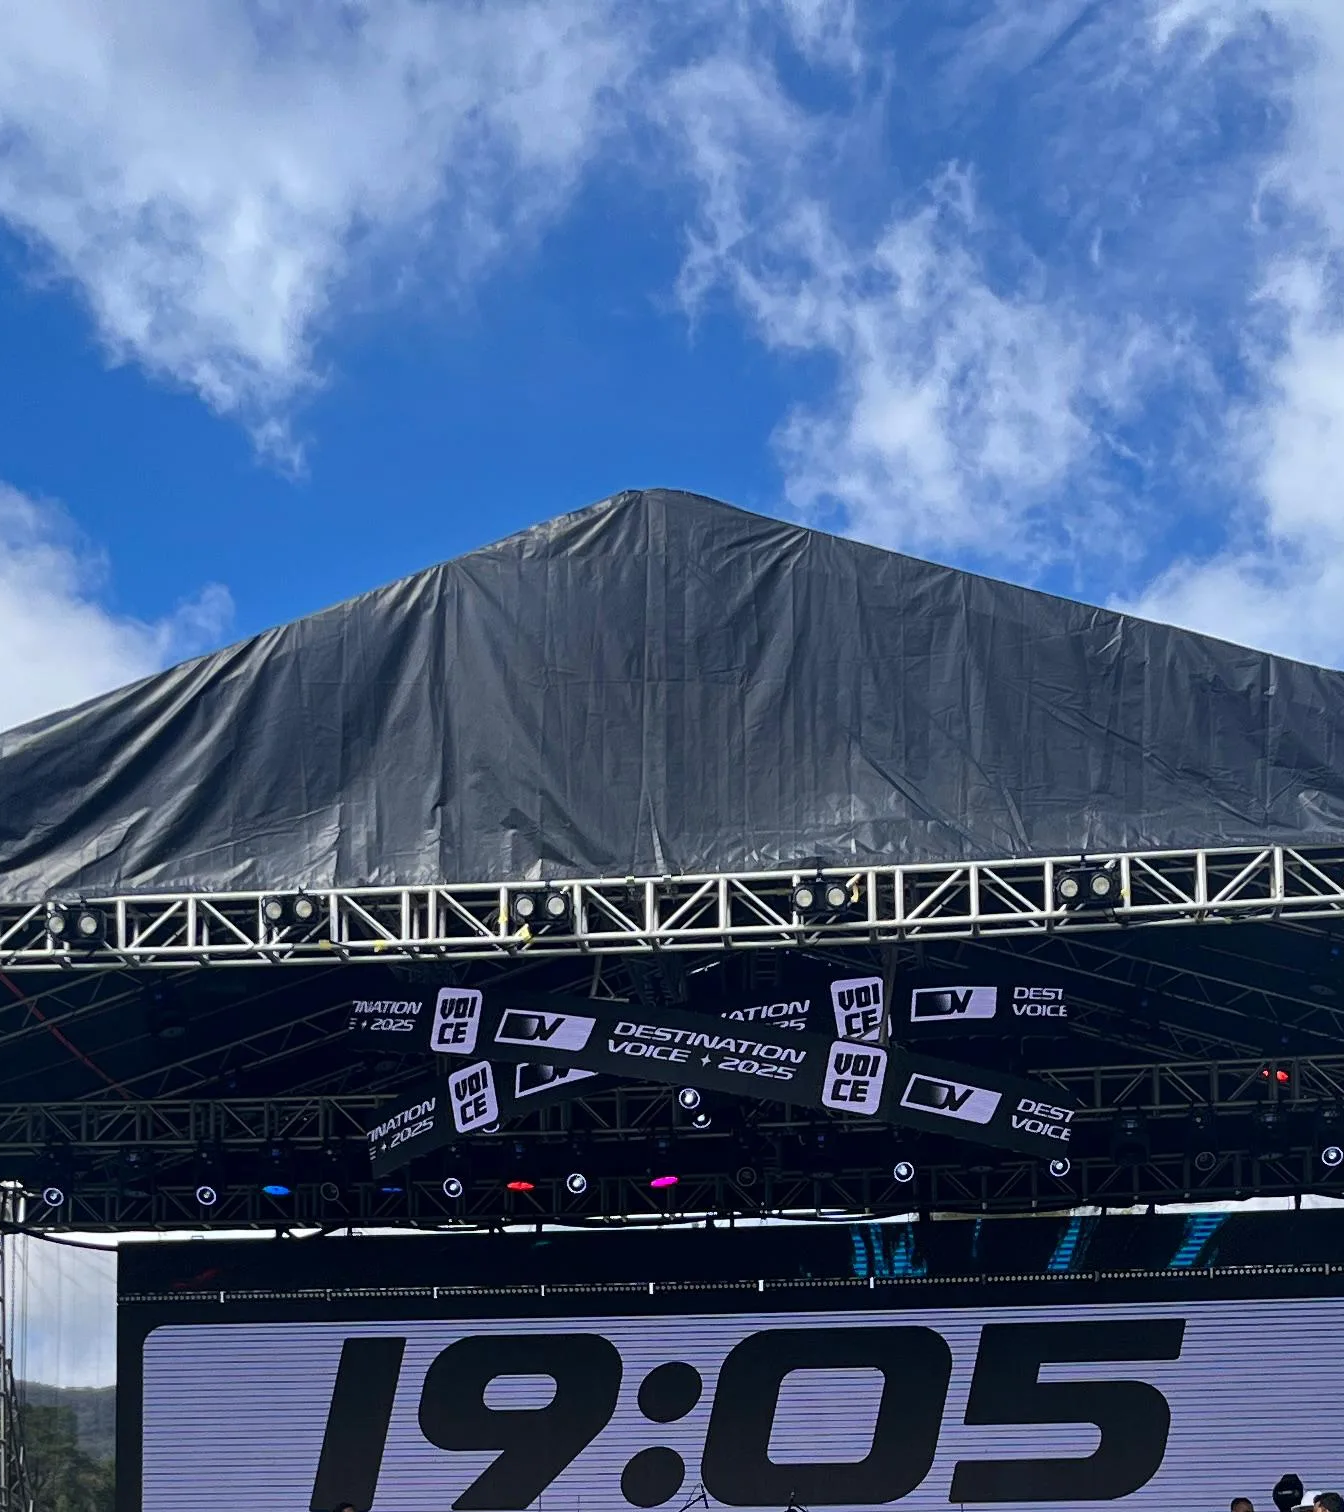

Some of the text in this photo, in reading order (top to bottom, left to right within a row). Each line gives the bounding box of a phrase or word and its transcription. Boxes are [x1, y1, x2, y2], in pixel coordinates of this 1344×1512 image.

[370, 1018, 417, 1031] 2025
[721, 999, 810, 1021] ATION
[1012, 1003, 1068, 1017] VOICE
[613, 1021, 807, 1064] DESTINATION
[607, 1038, 797, 1081] VOICE 2025
[390, 1115, 435, 1149] 2025
[1011, 1115, 1072, 1141] VOICE
[309, 1318, 1186, 1512] 19:05
